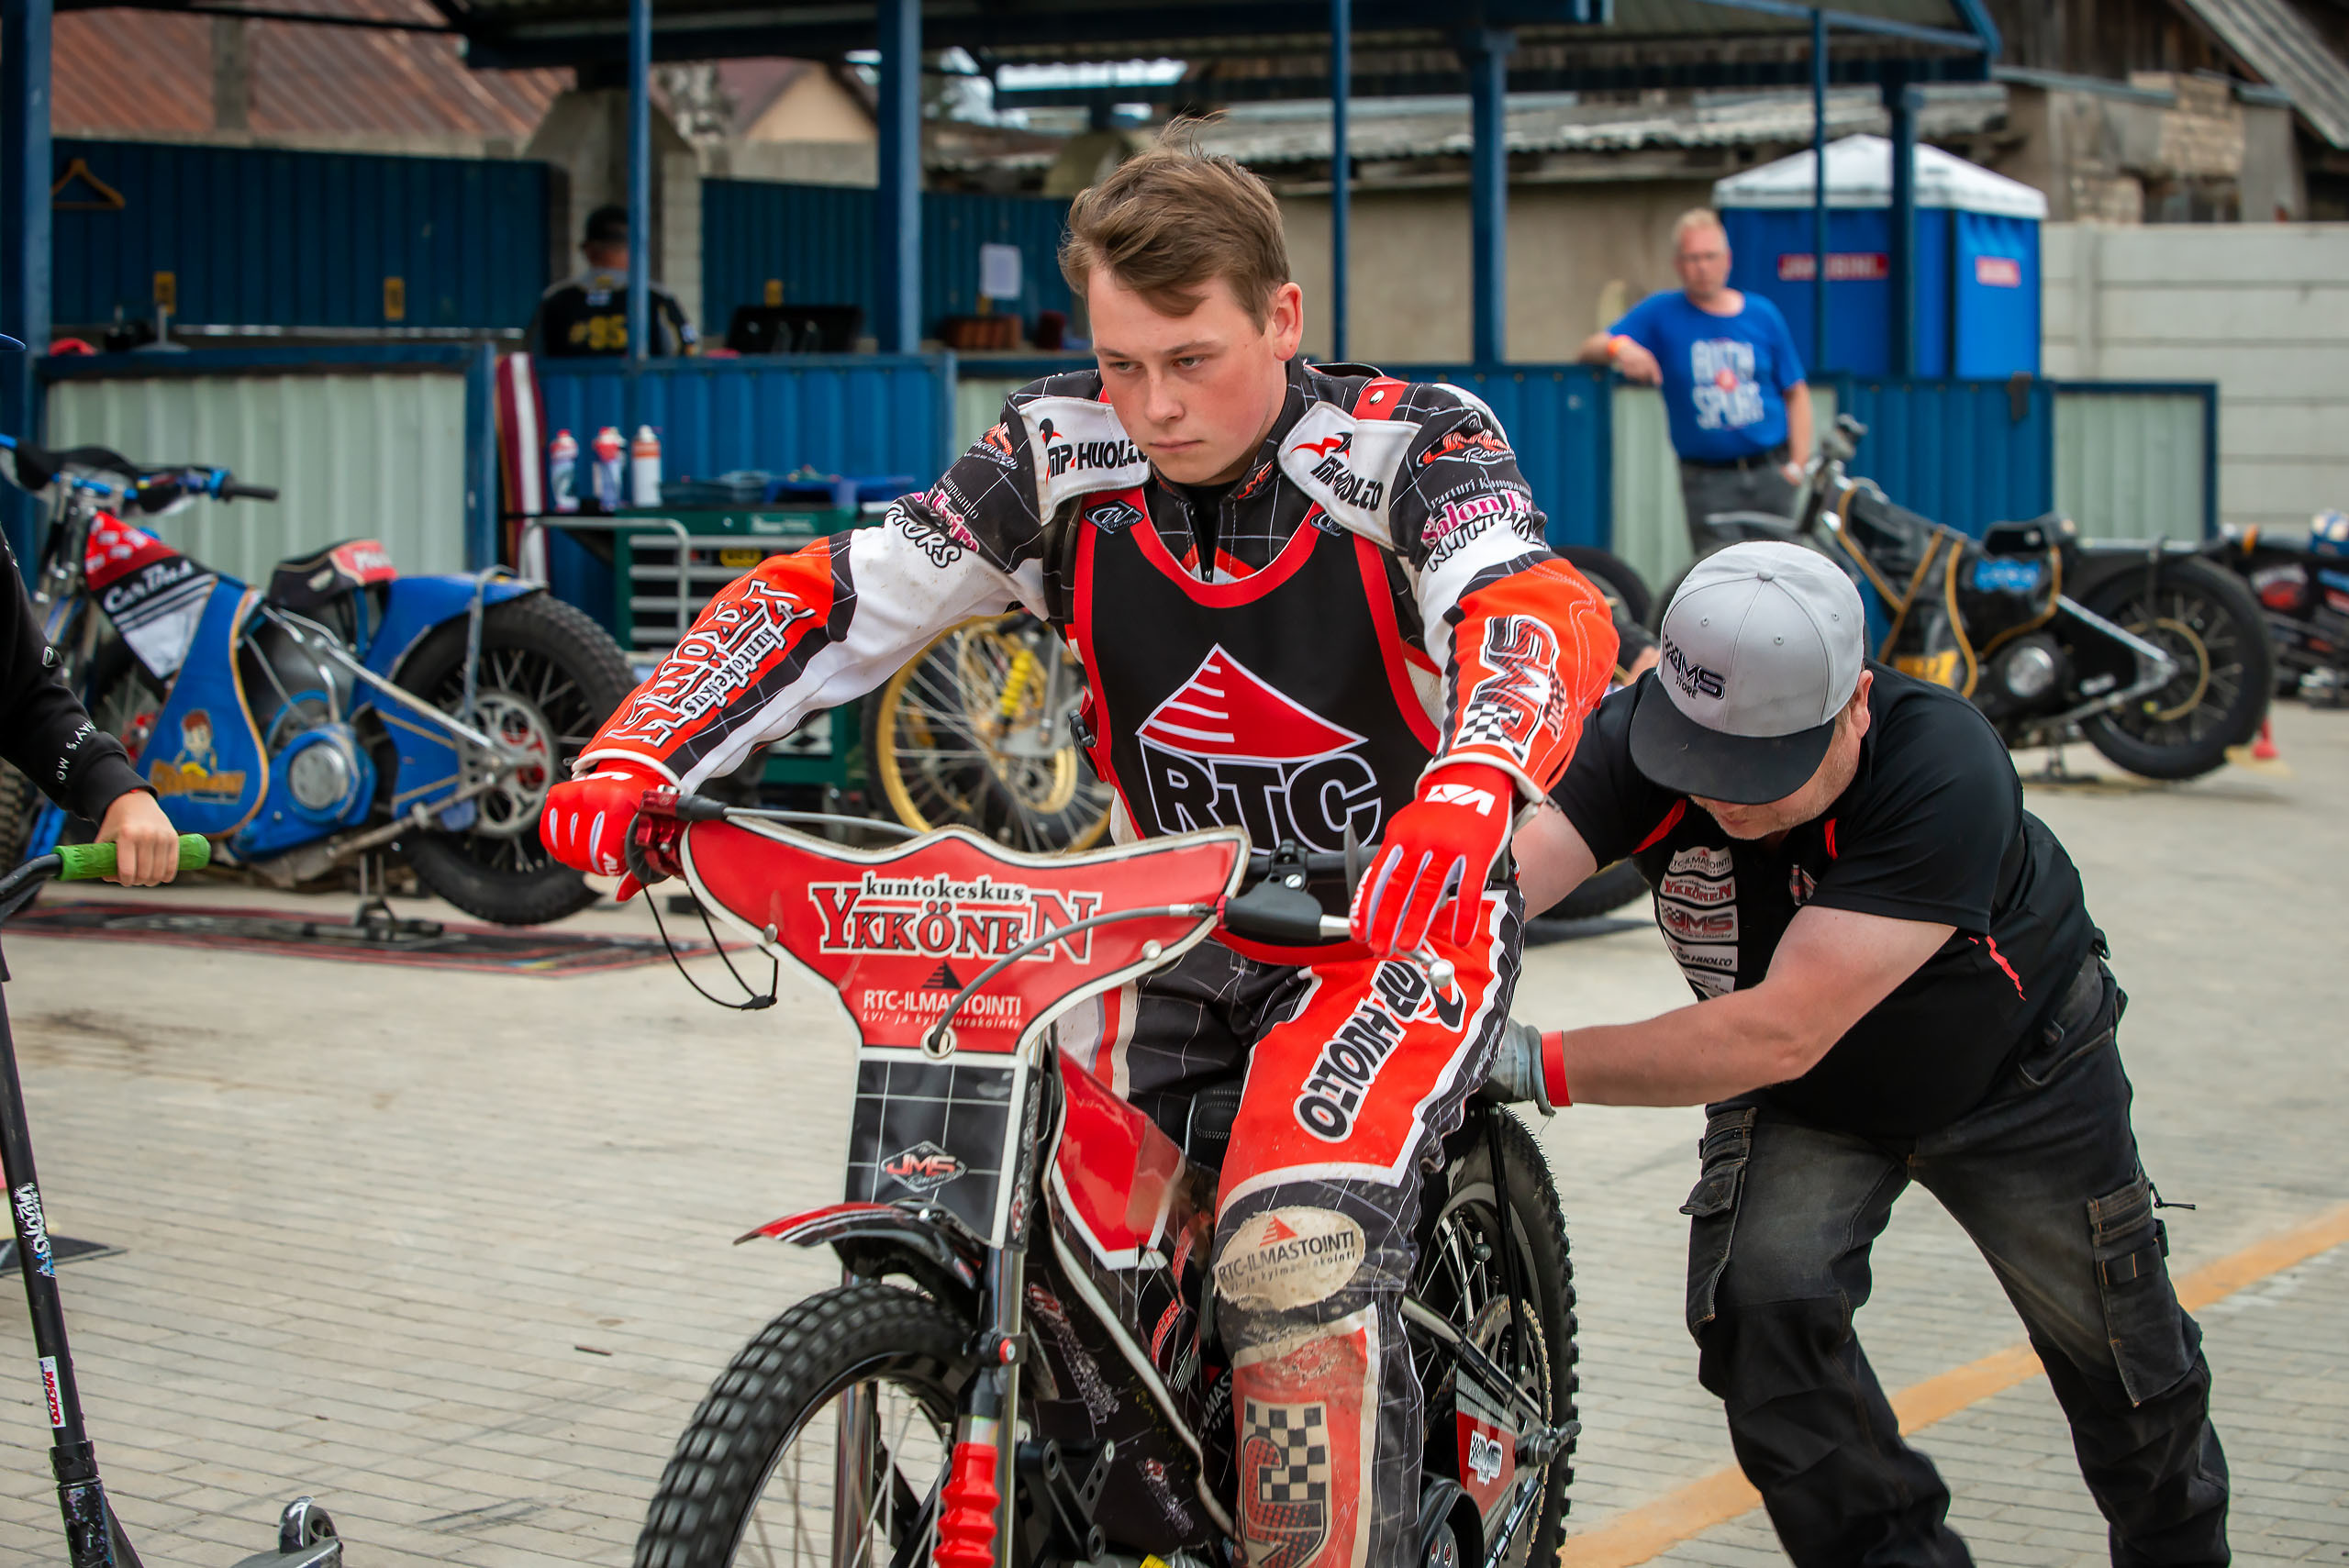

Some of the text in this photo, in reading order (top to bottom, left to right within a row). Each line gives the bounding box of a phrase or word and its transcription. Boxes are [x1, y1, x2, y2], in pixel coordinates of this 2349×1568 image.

[1420, 500, 1504, 550] Salon
[1139, 738, 1381, 855] RTC
[865, 873, 1025, 903] kuntokeskus
[809, 884, 1101, 963] YKKÖNEN
[1661, 903, 1734, 933] JMS
[886, 1153, 956, 1179] JMS
[1218, 1230, 1355, 1284] RTC-ILMASTOINTI
